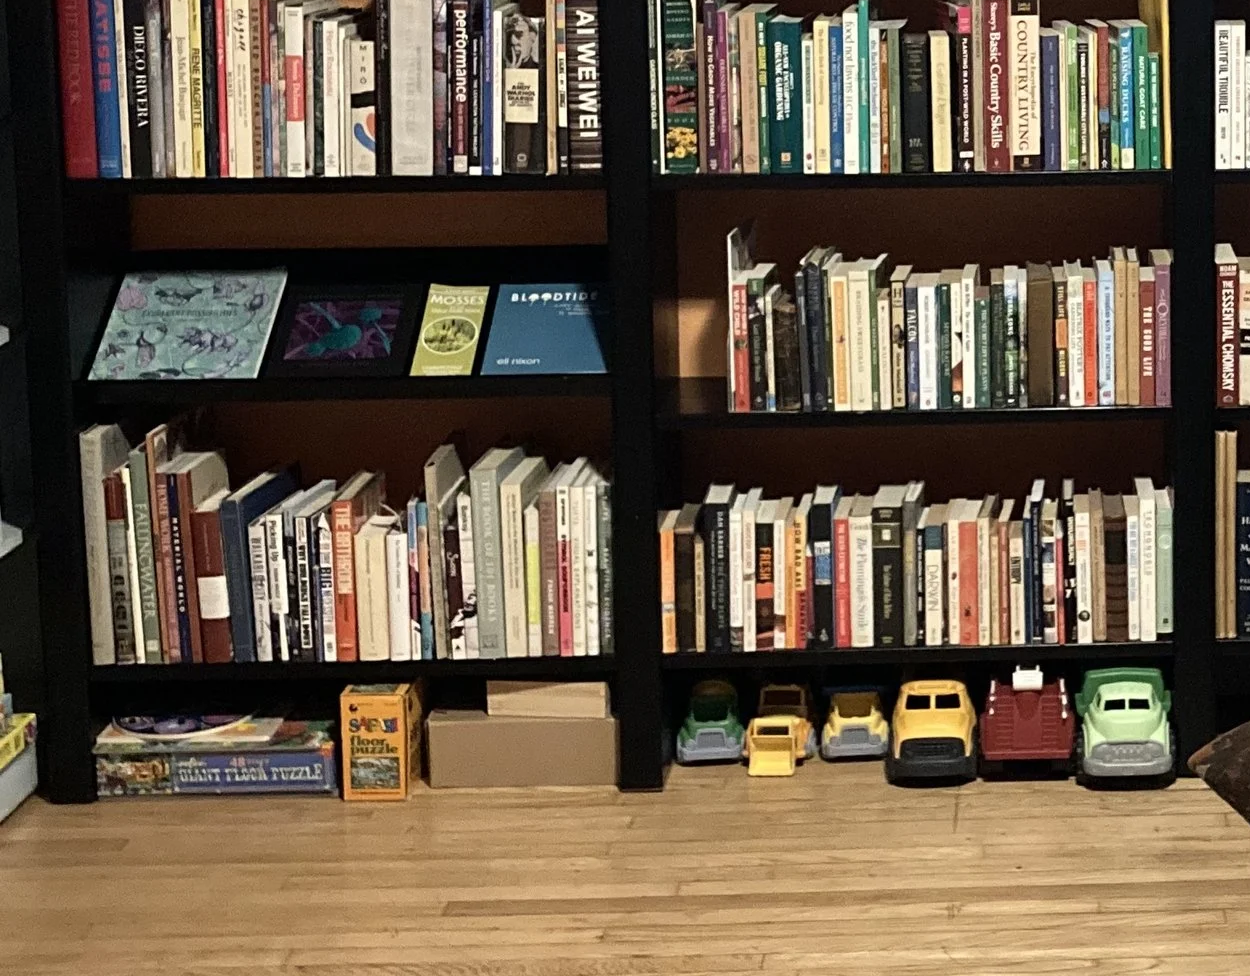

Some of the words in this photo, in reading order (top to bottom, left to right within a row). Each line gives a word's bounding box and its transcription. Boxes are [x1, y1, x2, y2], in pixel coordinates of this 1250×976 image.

[576, 9, 595, 36] AI
[133, 25, 145, 71] DIEGO
[175, 37, 187, 85] Jean-Michel
[454, 9, 468, 103] performance
[989, 31, 1001, 63] Basic
[1017, 20, 1028, 92] COUNTRY
[1218, 29, 1229, 74] BEAUTIFUL
[1121, 46, 1130, 86] RAISING
[135, 74, 149, 128] RIVERA
[192, 77, 203, 129] MAGRITTE
[577, 42, 598, 138] WEIWEI
[986, 63, 1002, 113] Country
[1138, 88, 1146, 107] GOAT
[1218, 77, 1229, 114] TROUBLE
[1121, 89, 1130, 124] DUCKS
[1139, 109, 1147, 130] CARE
[990, 114, 1003, 150] Skills
[1018, 97, 1030, 152] LIVING
[430, 293, 485, 305] MOSSES
[1142, 306, 1153, 324] THE
[1222, 288, 1234, 342] ESSENTIAL
[907, 309, 917, 343] FALCON
[1142, 329, 1153, 352] GOOD
[1142, 357, 1153, 378] LIFE
[1222, 343, 1235, 392] CHOMSKY
[482, 480, 491, 504] THE
[337, 505, 352, 530] THE
[483, 507, 493, 539] BOOK
[160, 519, 170, 553] WORK
[269, 520, 280, 550] Picking
[484, 542, 494, 557] OF
[135, 503, 156, 620] FALLINGWATER
[172, 517, 181, 572] MATERIAL
[177, 575, 188, 613] WORLD
[270, 551, 279, 563] Up
[759, 547, 772, 581] FRESH
[486, 584, 498, 622] BOOKS
[350, 736, 388, 748] floor
[350, 743, 399, 756] puzzle
[179, 767, 222, 783] GIANT
[270, 764, 324, 780] PUZZLE
